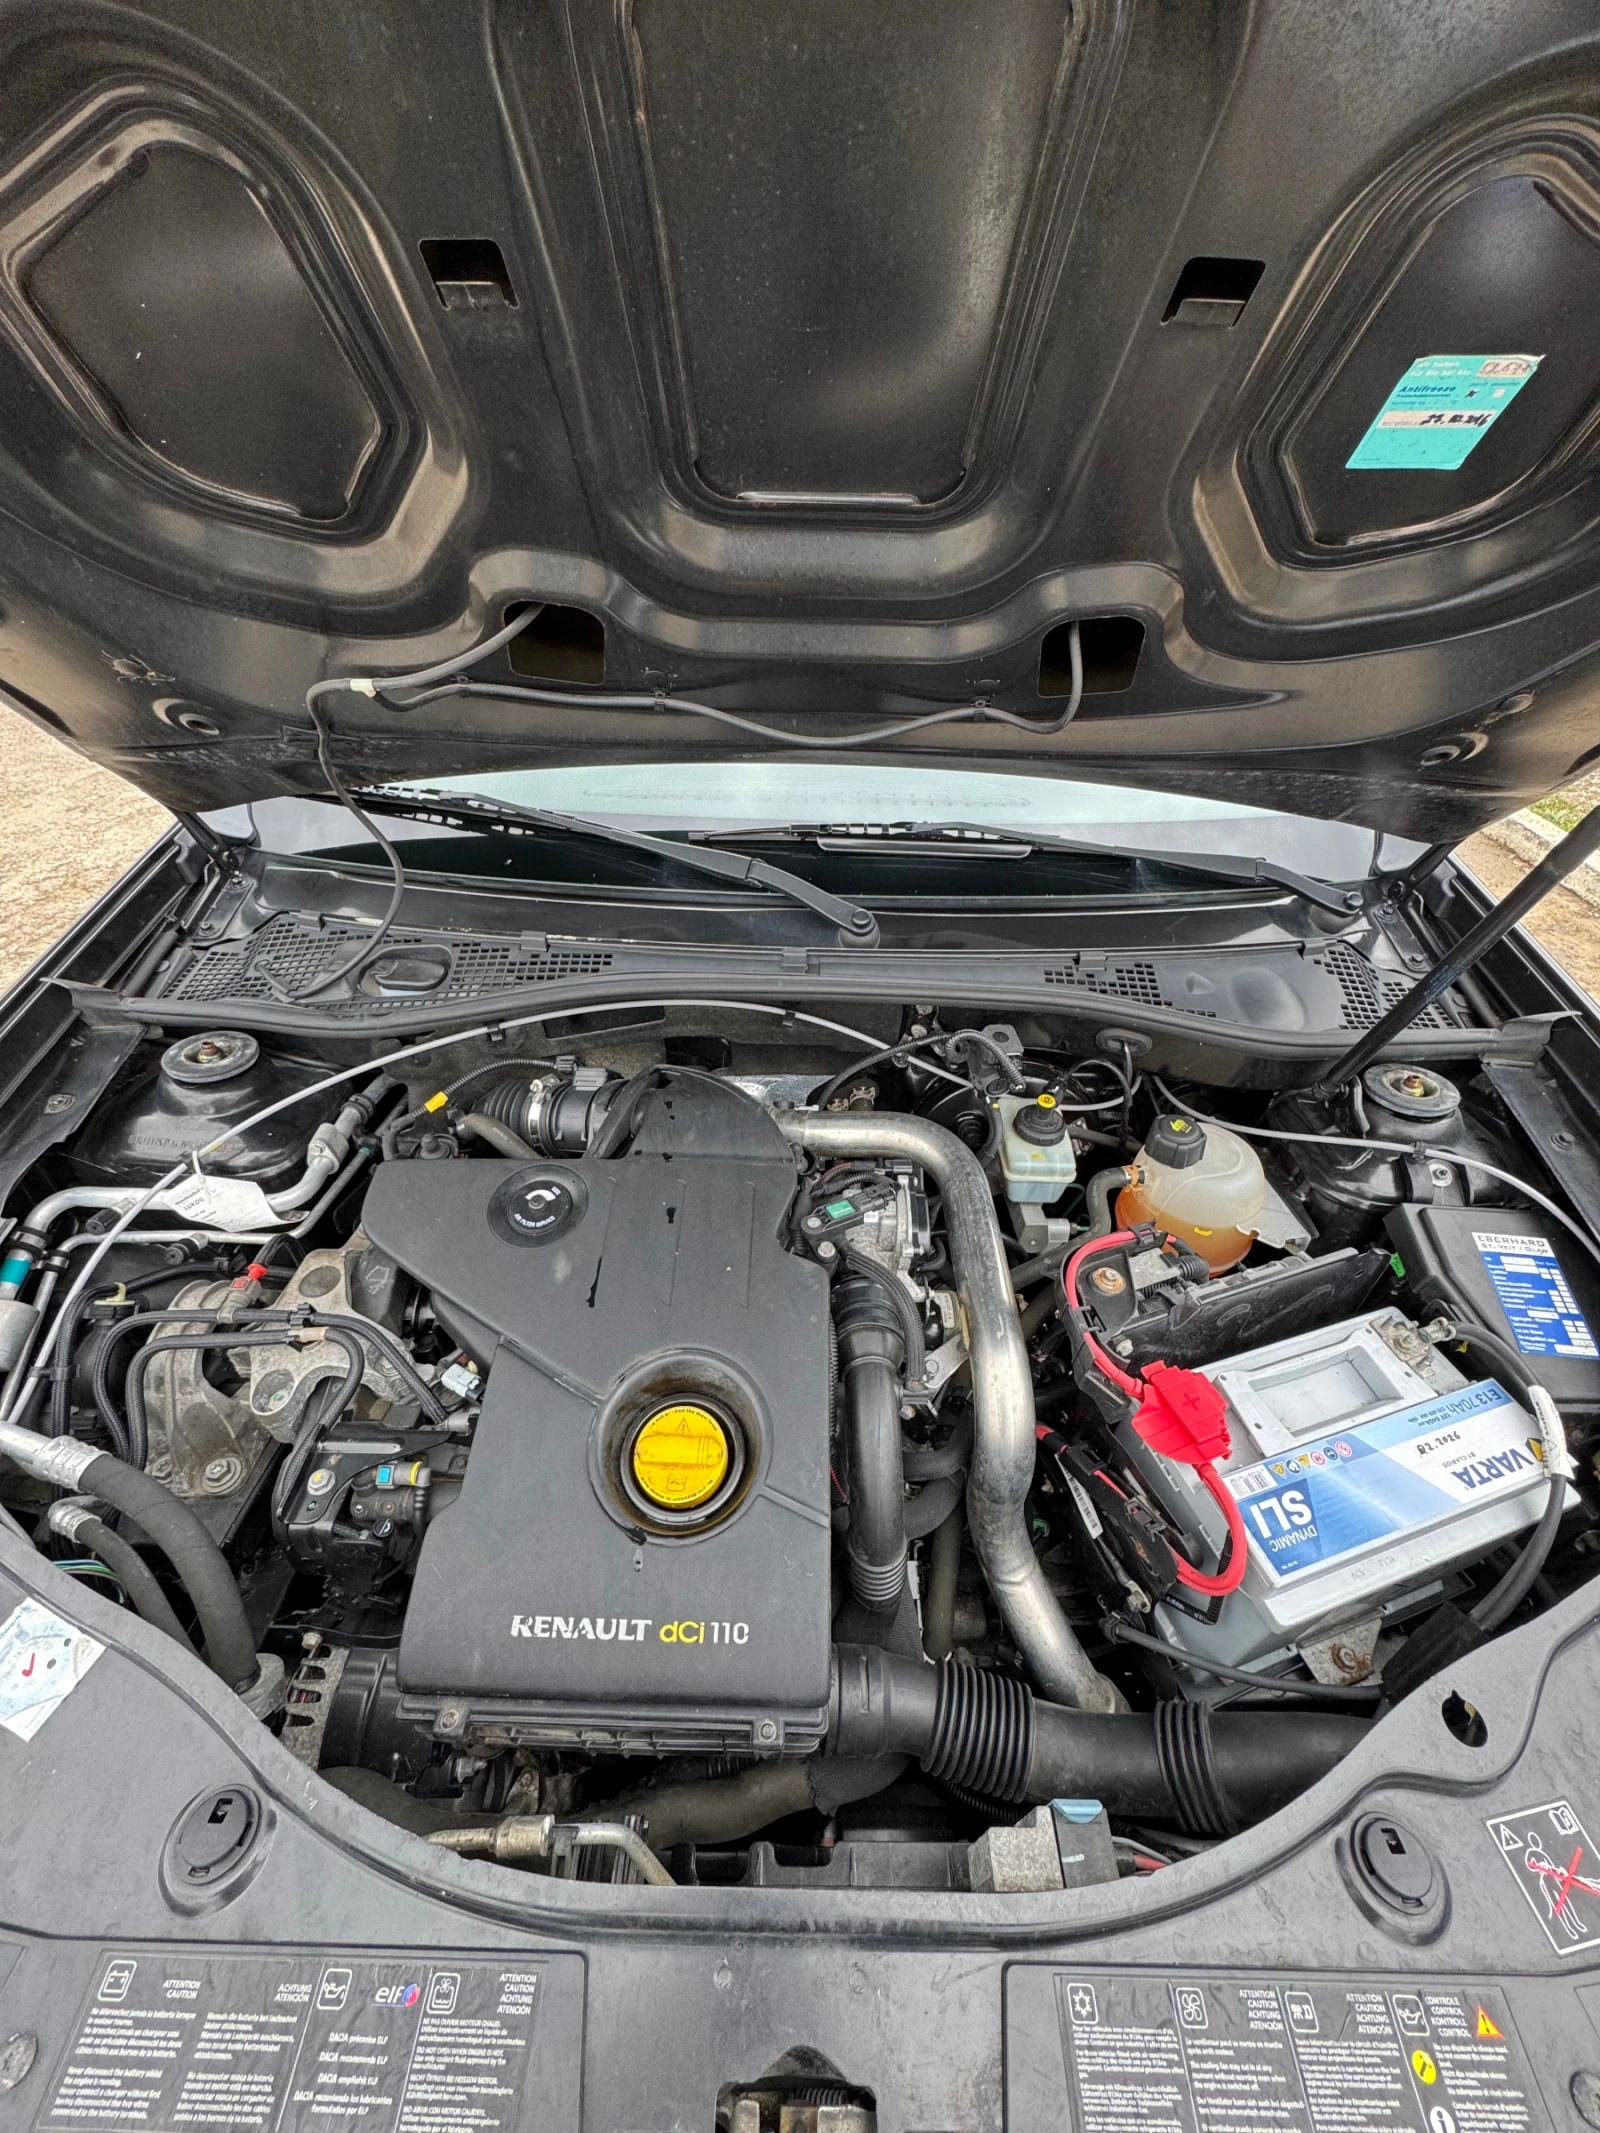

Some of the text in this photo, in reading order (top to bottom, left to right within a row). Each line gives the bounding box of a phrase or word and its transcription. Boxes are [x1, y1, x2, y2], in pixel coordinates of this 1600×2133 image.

[1399, 385, 1456, 393] Antifreeze
[1477, 1234, 1545, 1247] EBERHARD
[1482, 1242, 1496, 1250] ST.
[1446, 1388, 1502, 1414] E13 70Ah
[1442, 1452, 1476, 1468] BY CLARIOS
[1451, 1448, 1534, 1488] VARTA
[1249, 1490, 1312, 1538] SLI
[1269, 1525, 1318, 1552] DYNAMIC
[510, 1615, 750, 1645] RENAULT dCi 110
[500, 1973, 536, 1983] ATTENTION
[162, 1980, 202, 1990] ATTENTION
[278, 1984, 312, 1992] ACHTUNG
[504, 1984, 535, 1993] CAUTION
[166, 1989, 198, 1999] CAUTION
[274, 1992, 310, 2002] ATENCIÓN
[375, 1985, 404, 2004] elf
[1239, 1989, 1276, 1998] ATTENTION
[1346, 1993, 1383, 2002] ATTENTION
[500, 1994, 533, 2004] ACHTUNG
[1248, 2000, 1278, 2008] CAUTION
[496, 2004, 532, 2015] ATENCIÓN
[1355, 2004, 1386, 2013] CAUTION
[1431, 2006, 1464, 2016] CONTROL
[1248, 2010, 1281, 2019] ACHTUNG
[1356, 2014, 1389, 2023] ACHTUNG
[1250, 2020, 1284, 2030] ATENCIÓN
[1430, 2017, 1468, 2026] KONTROLL
[1358, 2024, 1392, 2035] ATENCIÓN
[1438, 2028, 1471, 2038] CONTROL
[328, 2032, 349, 2042] DACIA
[376, 2035, 388, 2045] ELF
[319, 2051, 339, 2063] DACIA
[376, 2055, 388, 2065] ELF
[317, 2073, 337, 2084] DACIA
[367, 2077, 378, 2086] ELF
[293, 2090, 314, 2102] DACIA
[311, 2104, 369, 2116] formulados por ELF
